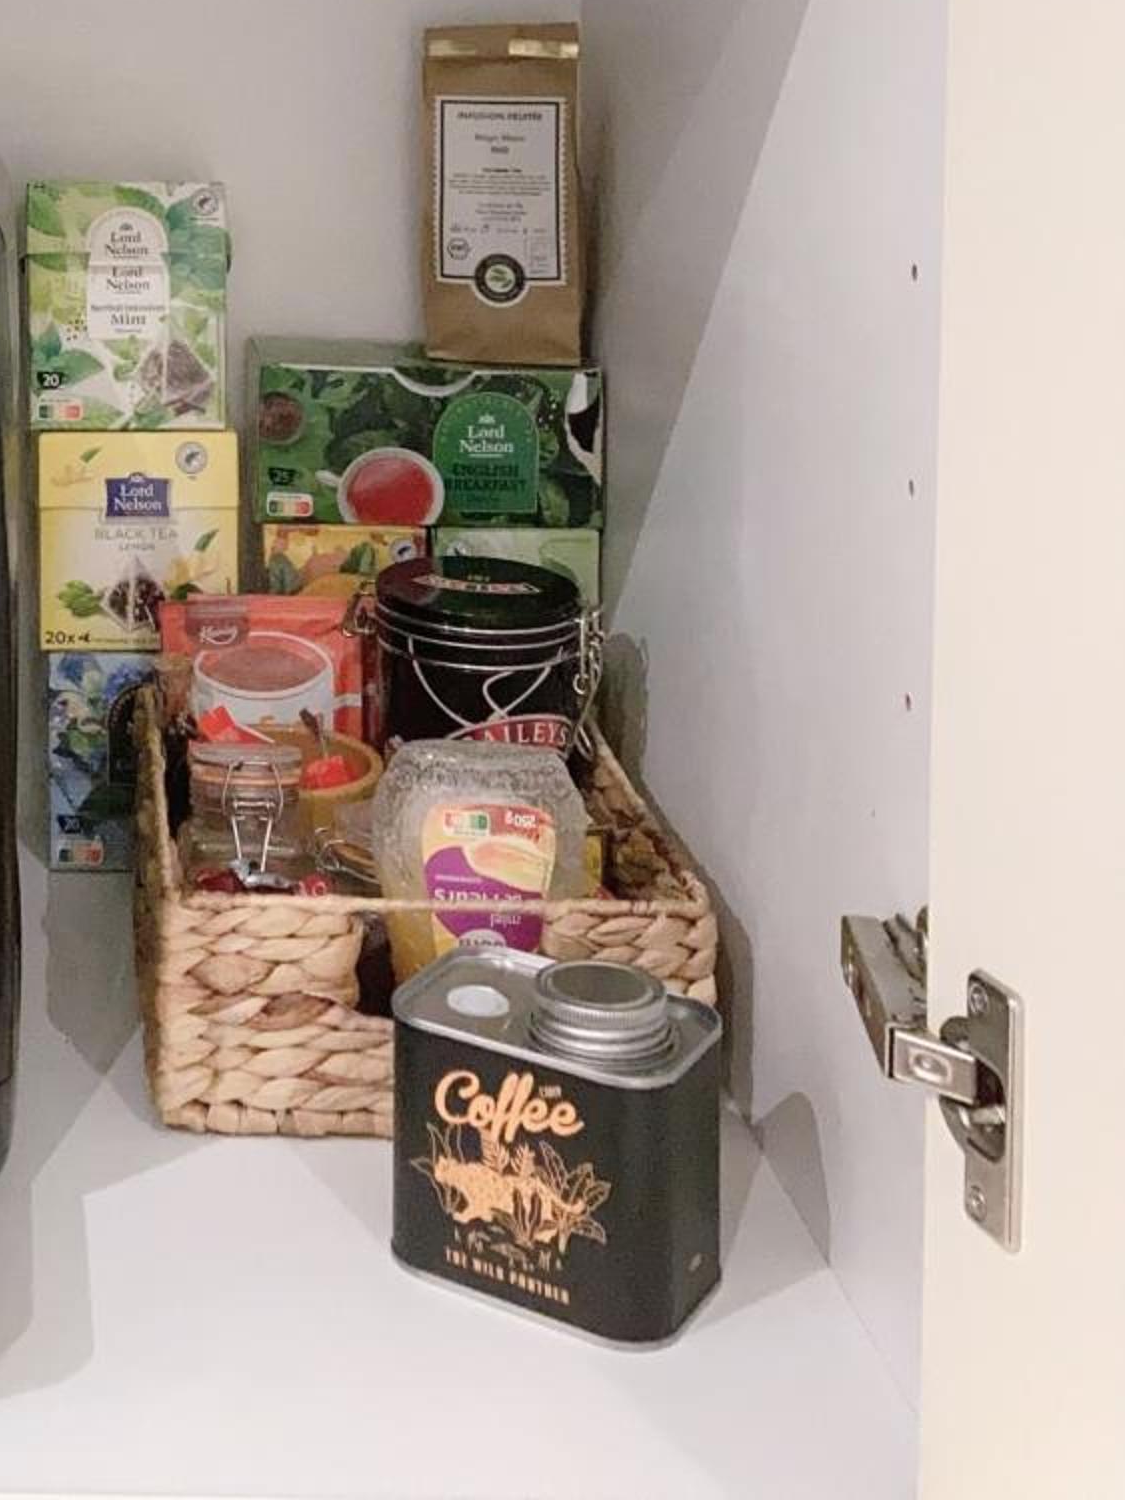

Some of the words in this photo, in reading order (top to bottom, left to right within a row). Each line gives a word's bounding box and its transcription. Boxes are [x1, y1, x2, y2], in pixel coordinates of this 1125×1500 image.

[110, 231, 142, 243] Lord
[105, 244, 149, 256] Nelson
[112, 266, 143, 277] Lord
[106, 279, 150, 291] Nelson
[110, 314, 146, 325] Mint
[42, 373, 60, 387] 20
[468, 424, 506, 439] Lord
[459, 440, 515, 453] Nelson
[120, 483, 155, 497] Lord
[114, 497, 163, 511] Nelson
[149, 526, 179, 541] TEA
[462, 720, 568, 748] AILEYS
[490, 913, 522, 928] miel
[434, 1069, 586, 1143] Coffee
